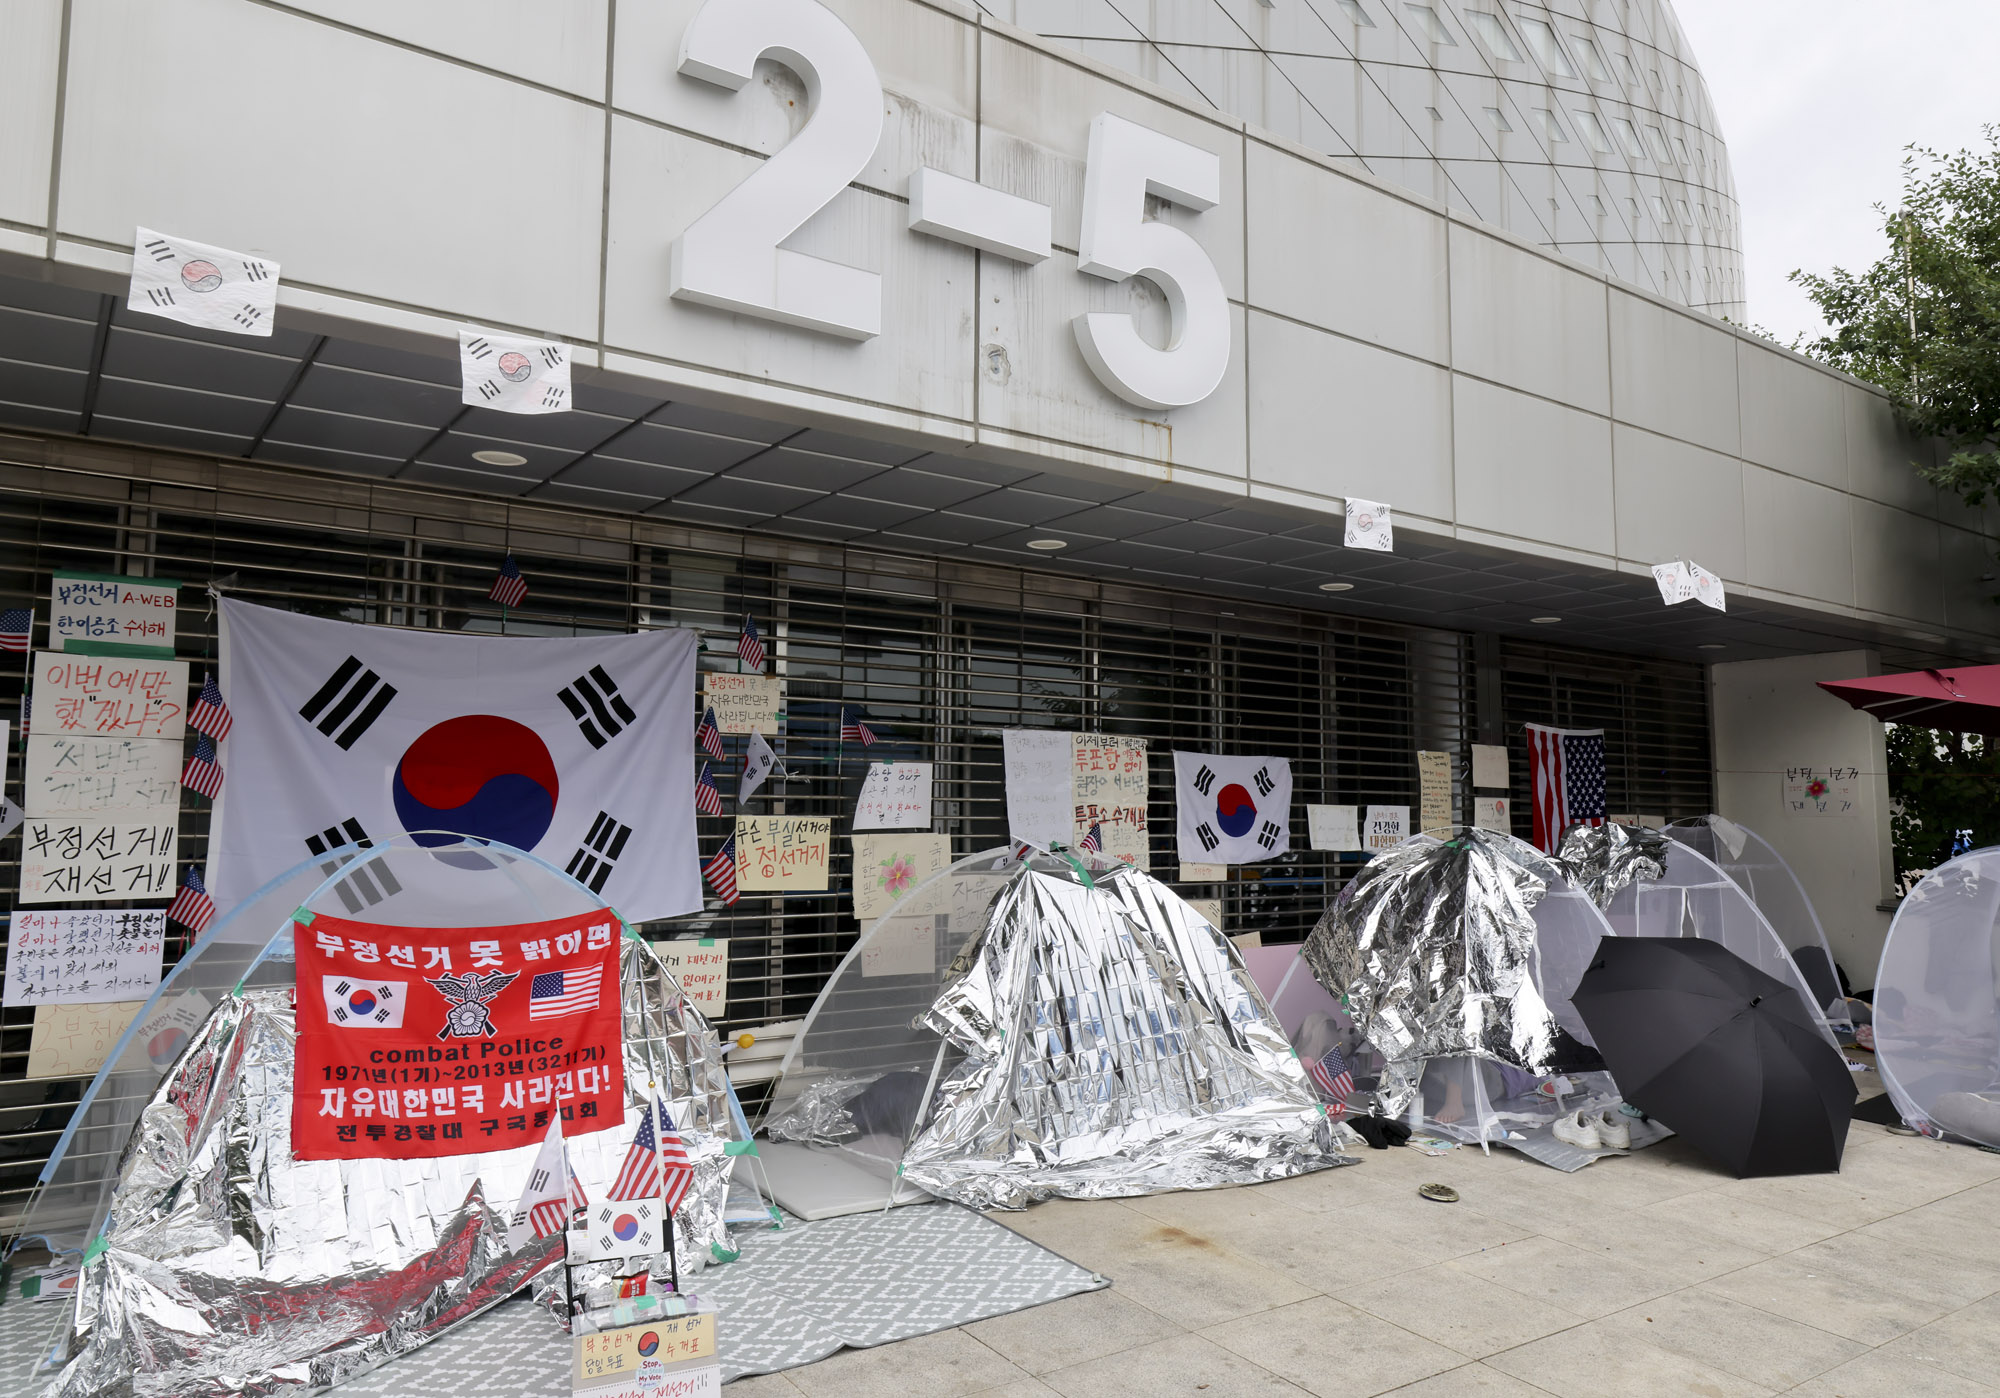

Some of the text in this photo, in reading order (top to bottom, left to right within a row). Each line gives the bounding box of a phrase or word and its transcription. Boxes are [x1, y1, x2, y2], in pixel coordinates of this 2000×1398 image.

[670, 0, 1231, 411] 2-5
[58, 583, 175, 608] 부정선거 A-WEB
[123, 619, 166, 637] 수사해
[709, 675, 746, 690] 부정선거
[1076, 734, 1119, 750] 이제부터
[1075, 748, 1121, 772] 투표함
[1372, 821, 1401, 834] 건강한
[115, 913, 164, 928] 부정선거
[315, 922, 612, 969] 부정선거 못 밝히면
[369, 1035, 563, 1064] combat Police
[318, 1065, 611, 1118] 자유대한민국 사라진다!
[335, 1122, 463, 1142] 전투경찰대
[642, 1360, 659, 1370] Stop
